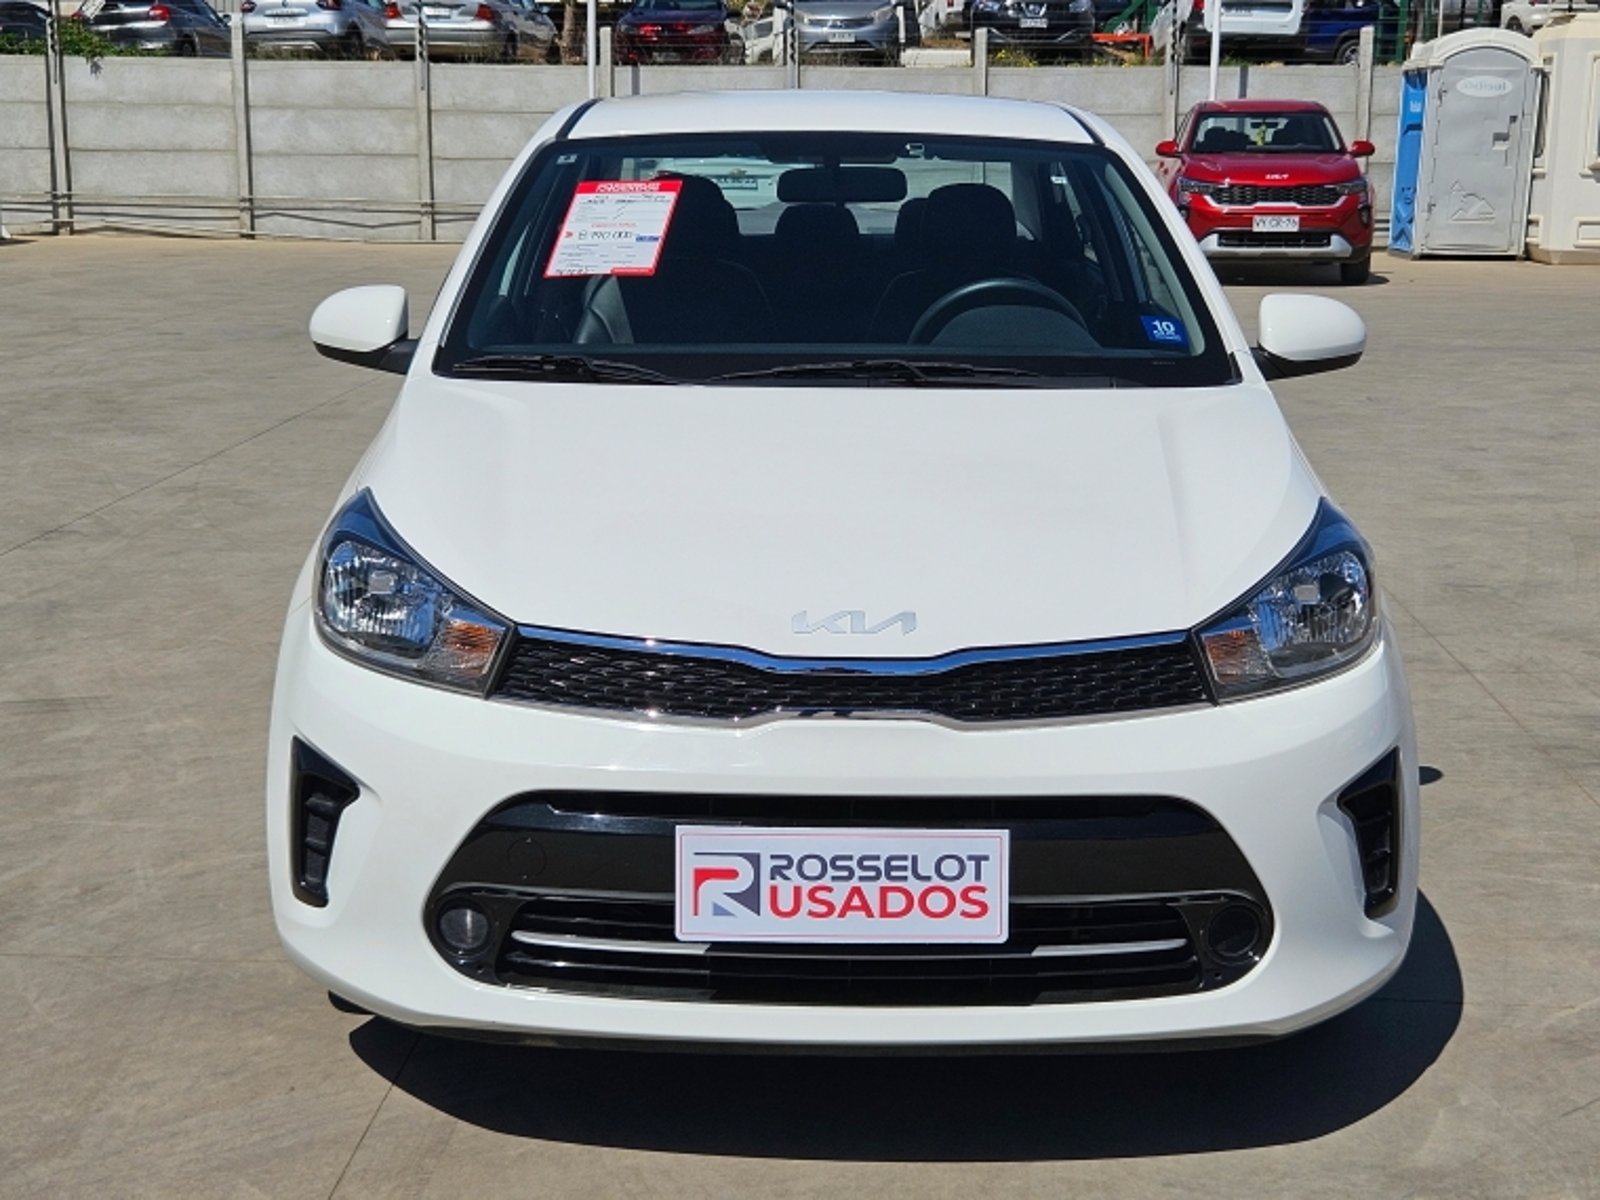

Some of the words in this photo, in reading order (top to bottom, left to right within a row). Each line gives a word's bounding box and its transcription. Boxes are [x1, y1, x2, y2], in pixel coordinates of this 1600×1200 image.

[791, 610, 917, 636] KIA
[769, 854, 990, 882] ROSSELOT
[769, 885, 990, 919] USADOS
